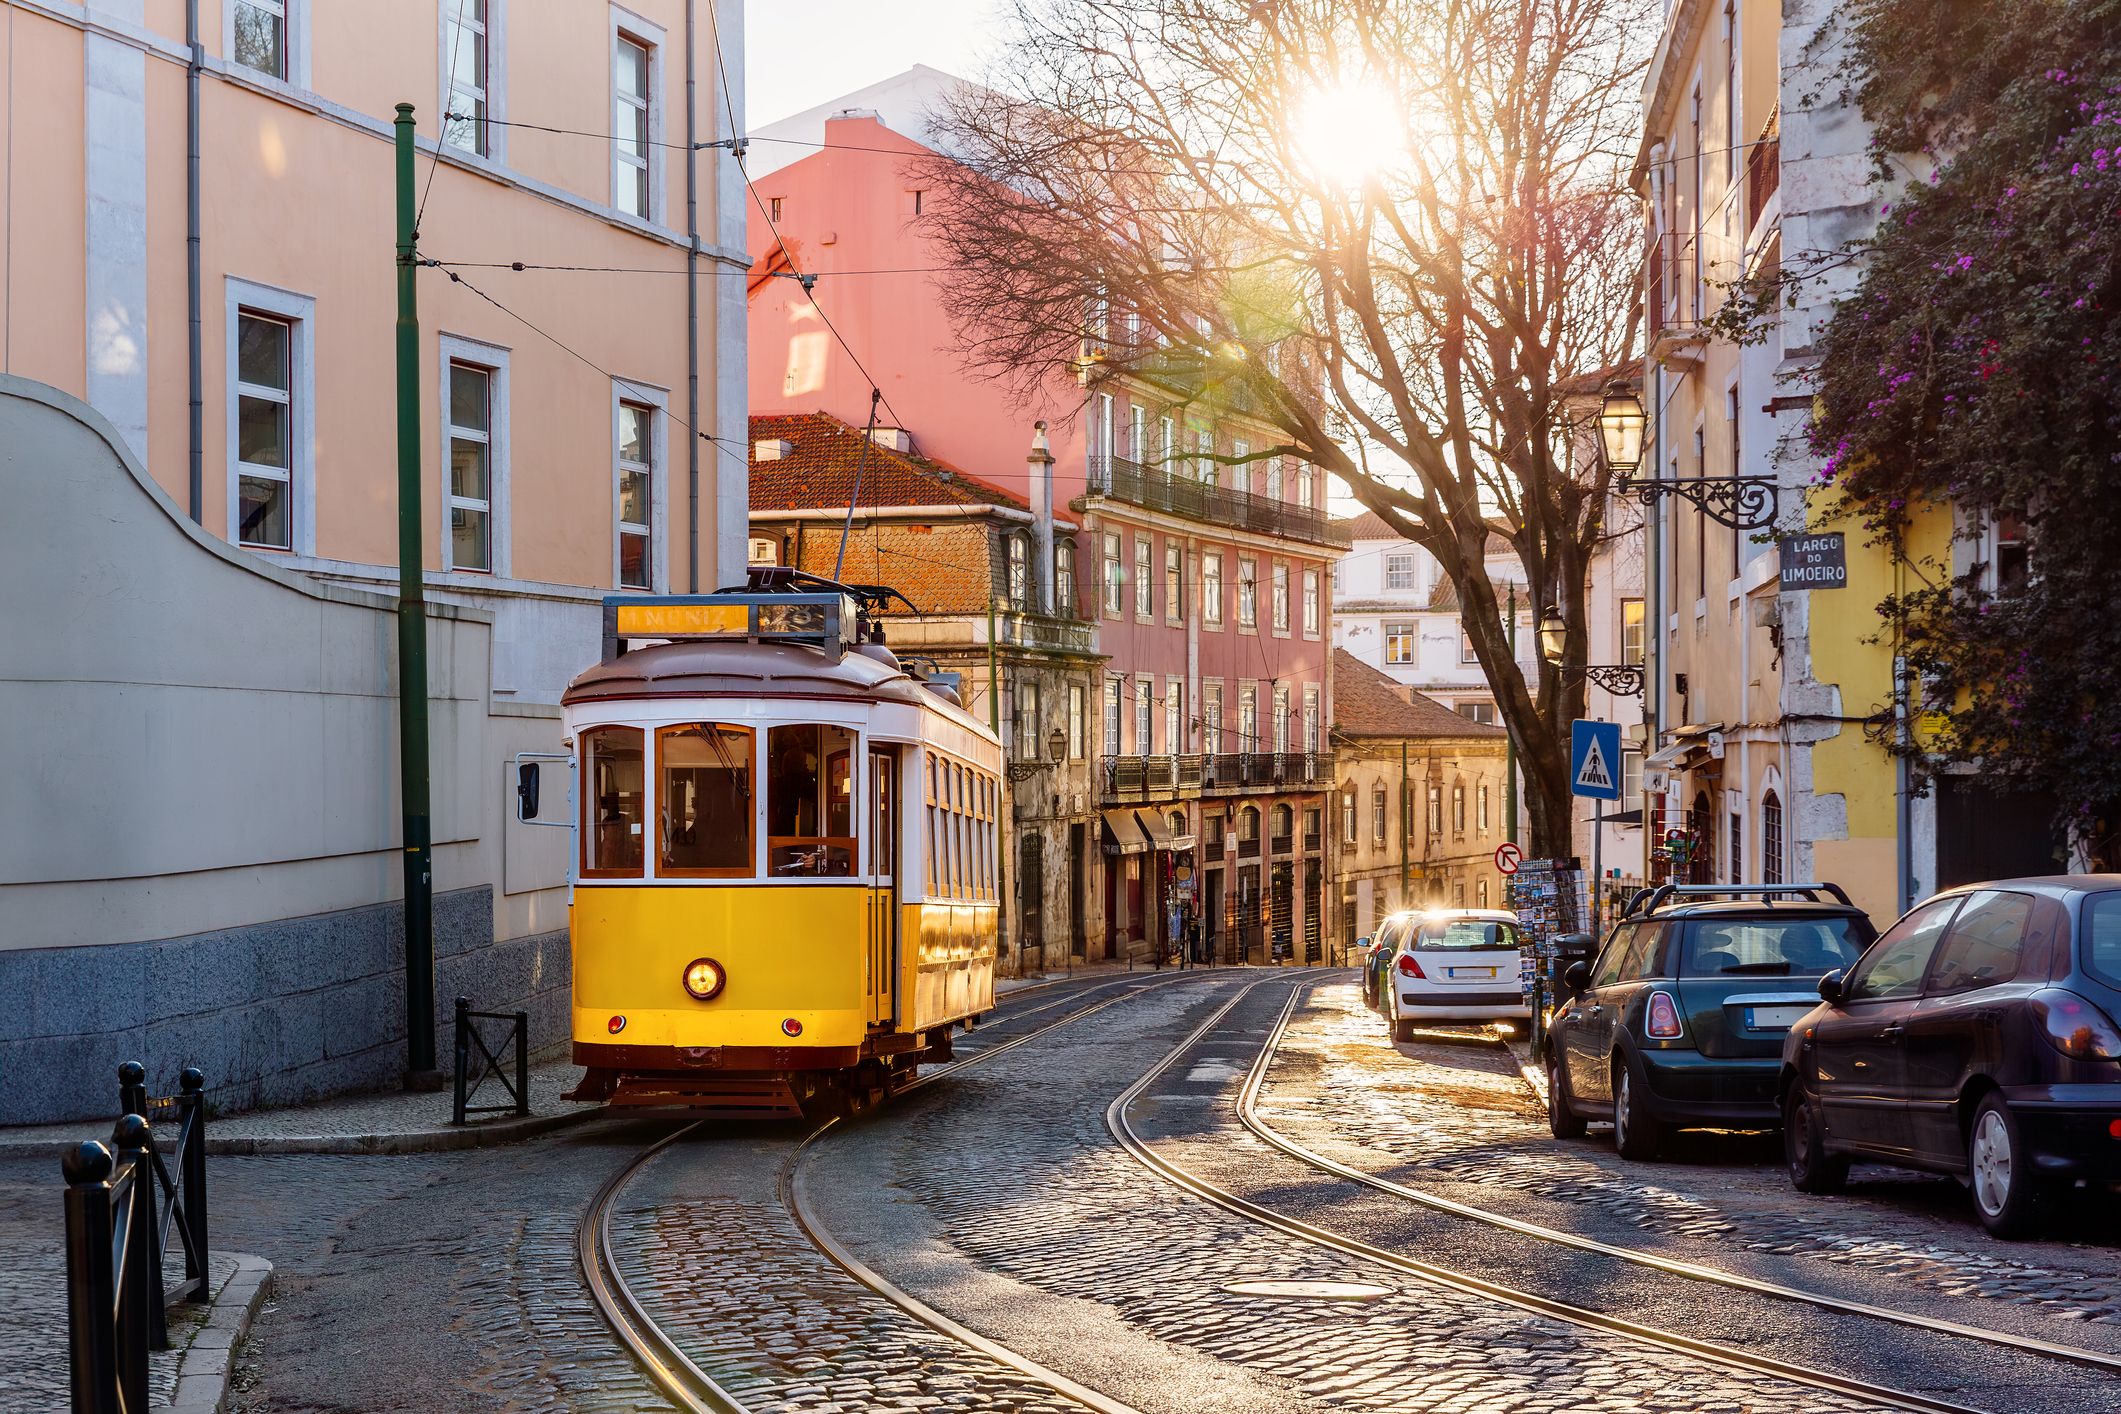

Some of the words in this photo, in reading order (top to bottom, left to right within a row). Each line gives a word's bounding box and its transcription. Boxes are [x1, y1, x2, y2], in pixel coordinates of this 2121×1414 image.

[1794, 538, 1838, 552] LARGO
[1807, 554, 1822, 563] DO
[1783, 566, 1845, 582] LIMOEIRO
